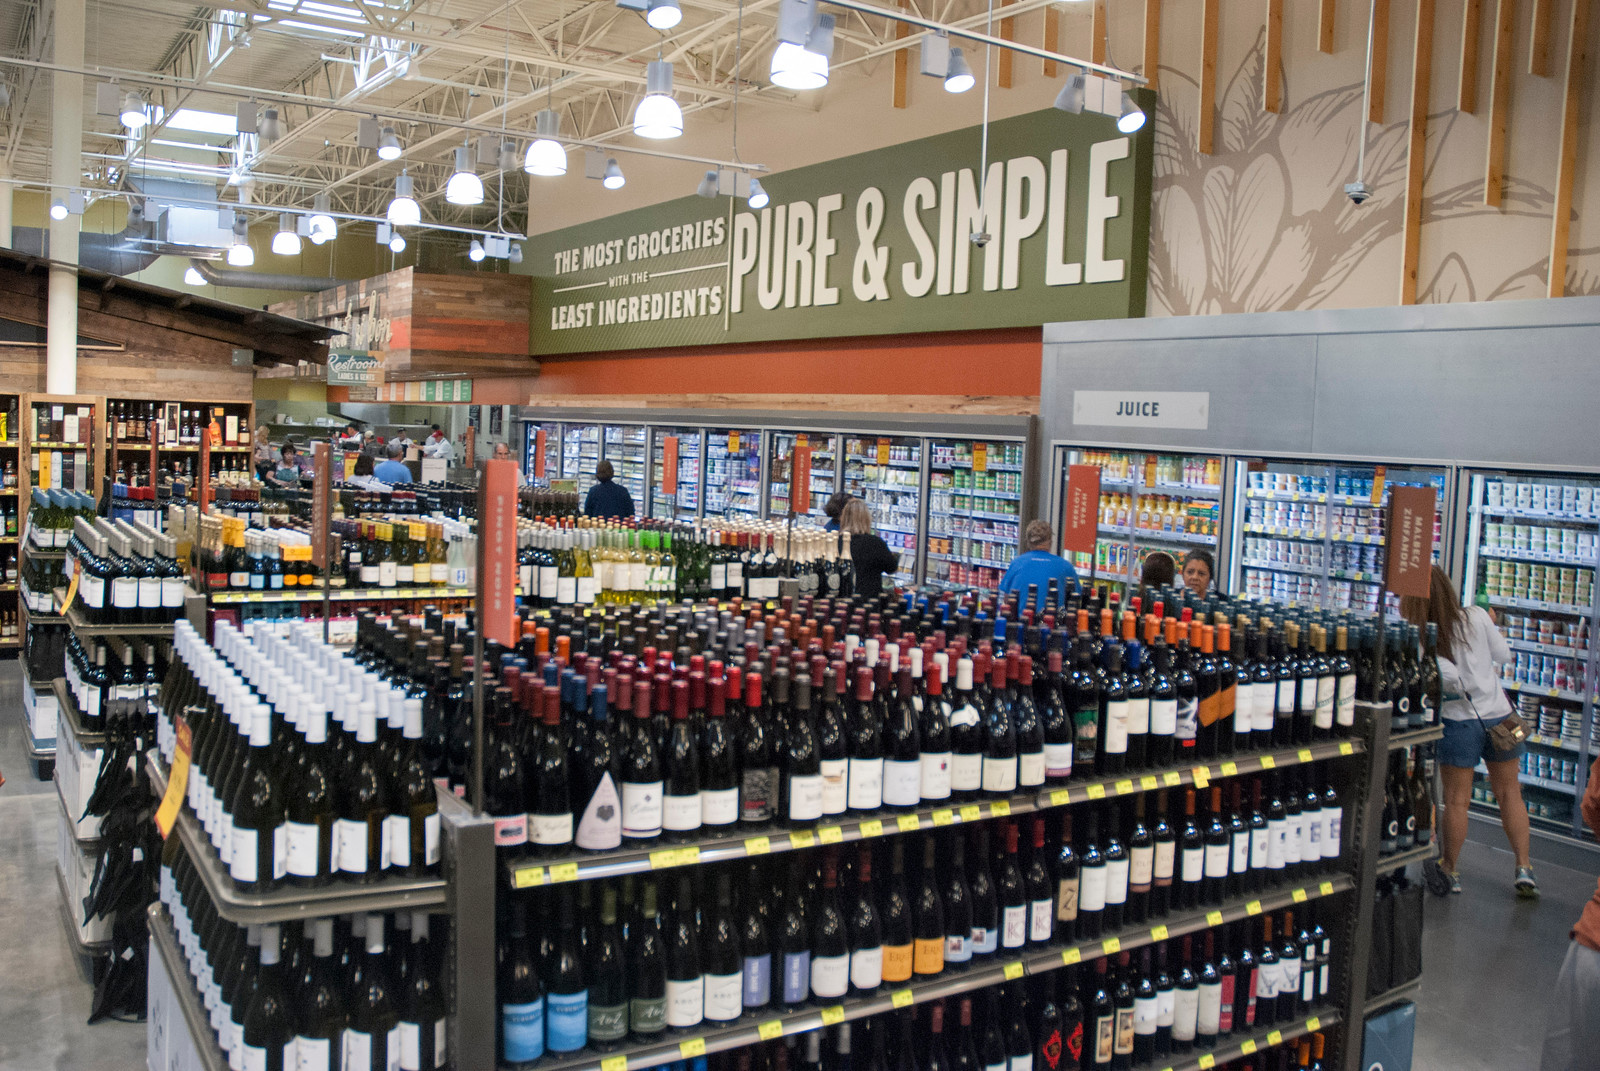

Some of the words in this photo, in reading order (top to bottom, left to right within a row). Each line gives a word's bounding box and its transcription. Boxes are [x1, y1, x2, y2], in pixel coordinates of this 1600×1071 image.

[554, 248, 580, 275] THE
[583, 239, 624, 270] MOST
[626, 217, 727, 261] GROCERIES
[731, 193, 844, 313] PURE
[852, 186, 890, 302] &
[901, 137, 1130, 298] SIMPLE
[608, 273, 629, 288] WITH
[631, 270, 649, 284] THE
[551, 302, 595, 330] LEAST
[598, 285, 723, 326] INGREDIENTS
[1116, 401, 1160, 417] JUICE
[495, 495, 504, 555] PINOT
[1072, 487, 1082, 528] MERLOT/
[1080, 493, 1088, 524] SYRAH
[1399, 507, 1413, 574] ZINFANDEL
[1409, 515, 1424, 568] MALBEC/
[494, 561, 502, 610] NOIR
